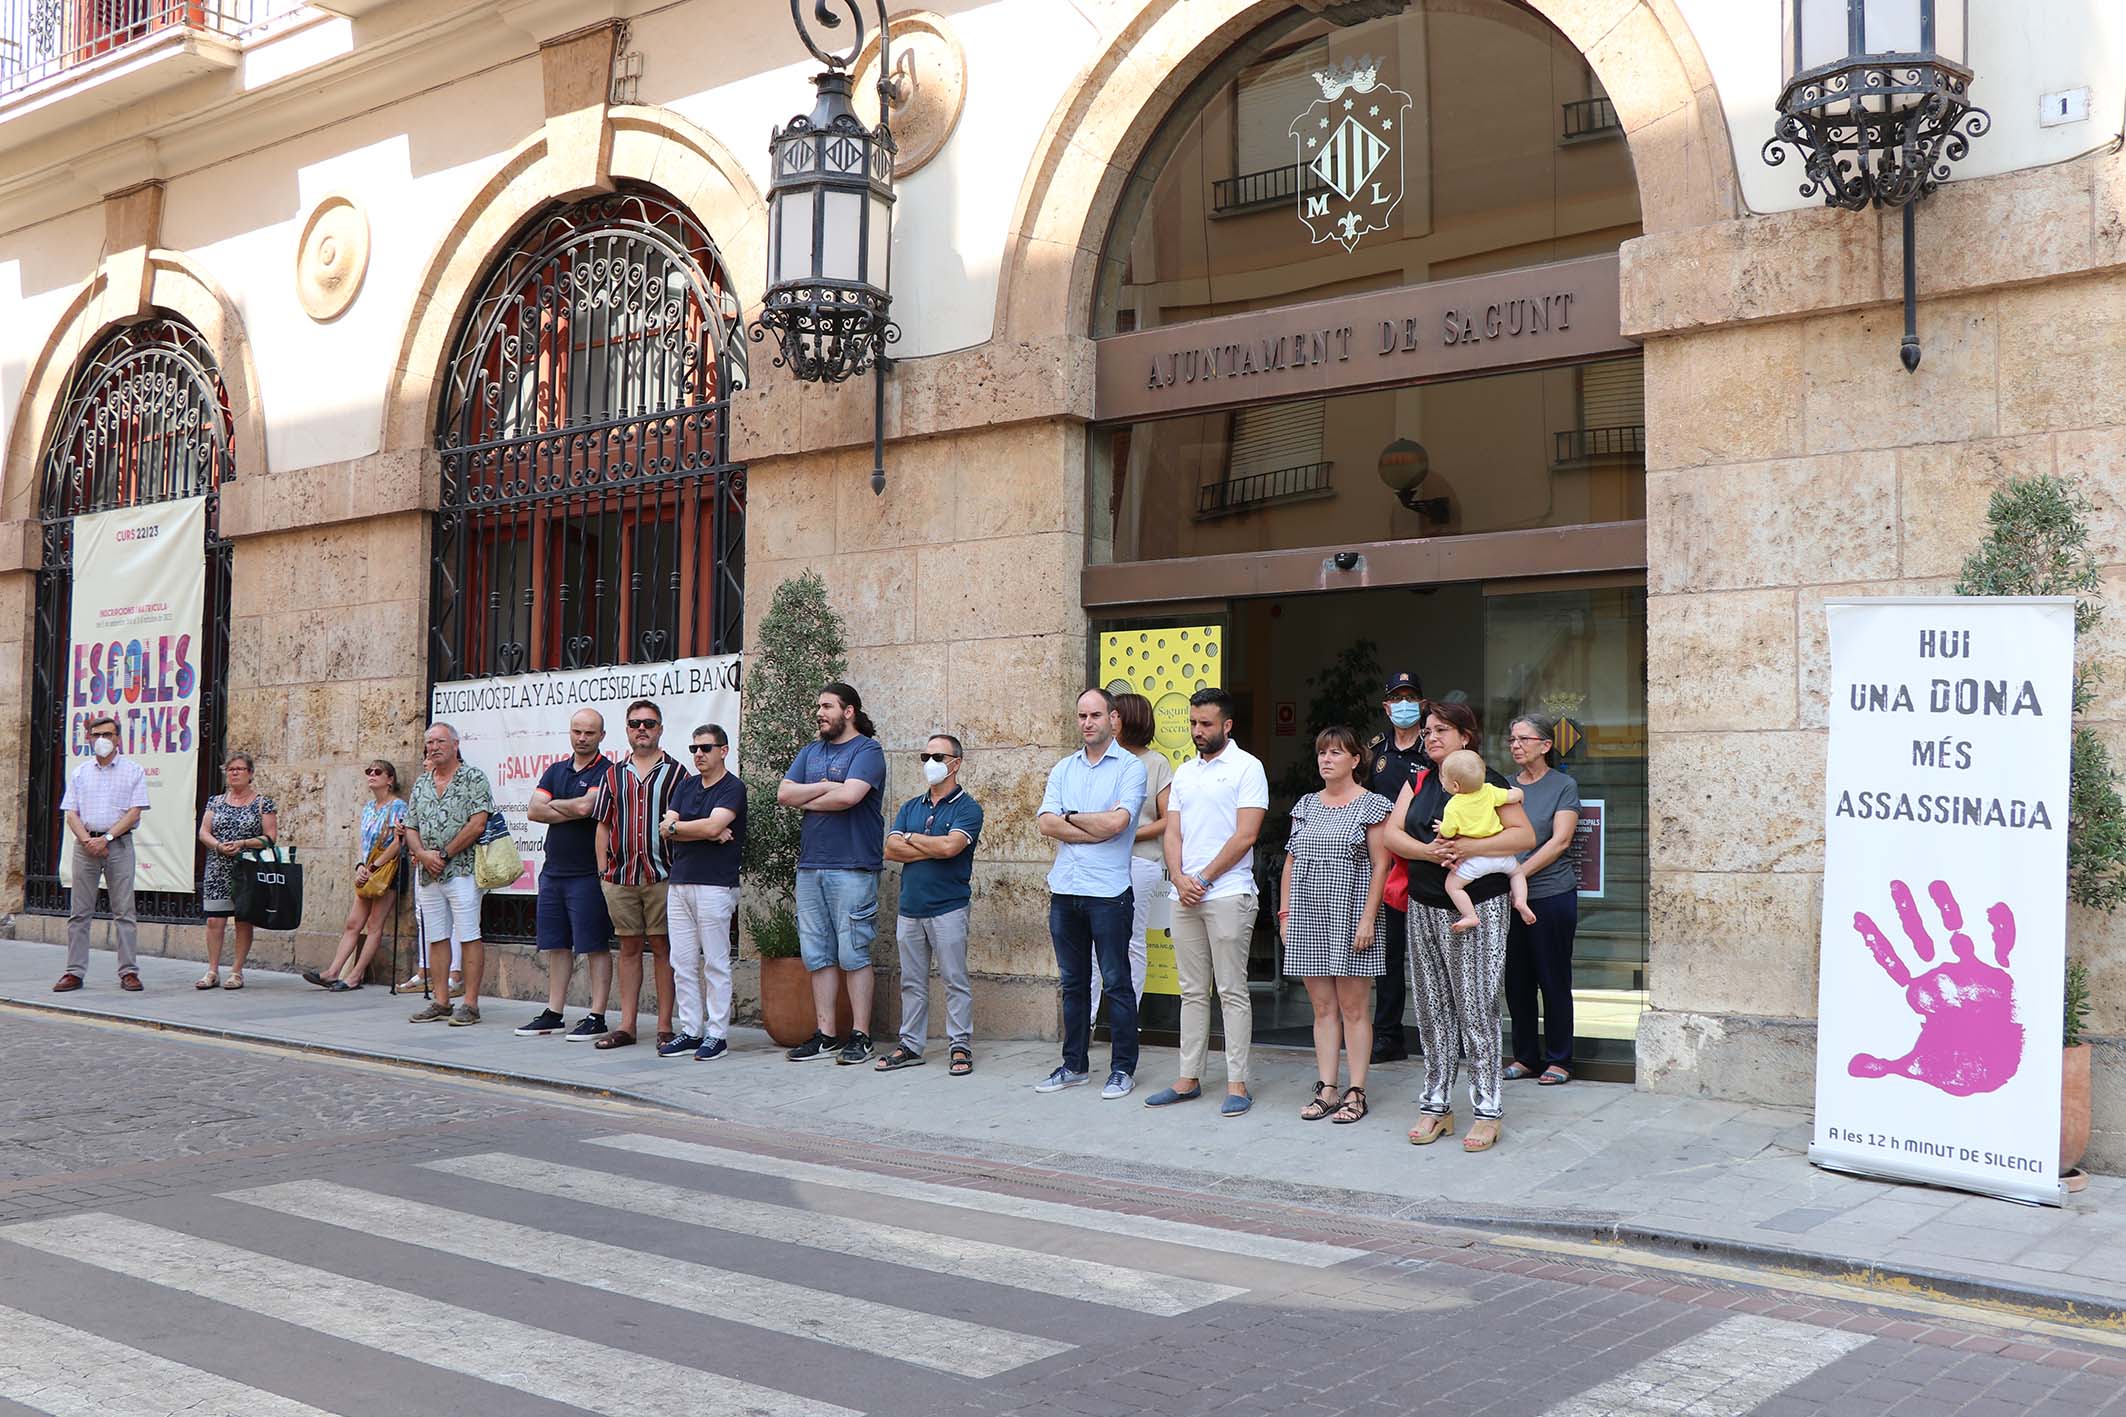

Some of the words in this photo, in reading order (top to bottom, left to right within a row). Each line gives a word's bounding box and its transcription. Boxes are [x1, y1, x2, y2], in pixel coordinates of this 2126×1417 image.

[2057, 97, 2069, 116] 1
[1306, 193, 1331, 219] M
[1370, 182, 1393, 206] L
[1146, 326, 1353, 390] AJUNTAMENT
[1378, 316, 1418, 357] DE
[1443, 292, 1576, 347] SAGUNT
[116, 528, 136, 542] CURS
[1919, 629, 1970, 659] HUI
[73, 633, 196, 708] ESCOLES
[434, 687, 500, 715] EXIGIMOS
[503, 681, 564, 710] PLAYAS
[567, 672, 658, 704] ACCESIBLES
[661, 670, 685, 696] AL
[1850, 683, 1915, 713] UNA
[1929, 677, 2043, 717] DONA
[1912, 735, 1973, 770] MÉS
[510, 820, 529, 832] hastag
[1835, 789, 2053, 830] ASSASSINADA
[1843, 1129, 1864, 1144] les
[1868, 1133, 1886, 1148] 12
[1891, 1136, 1900, 1150] h
[1904, 1139, 1955, 1159] MINUT
[1960, 1147, 1980, 1163] DE
[1984, 1151, 2043, 1174] SILENCI
